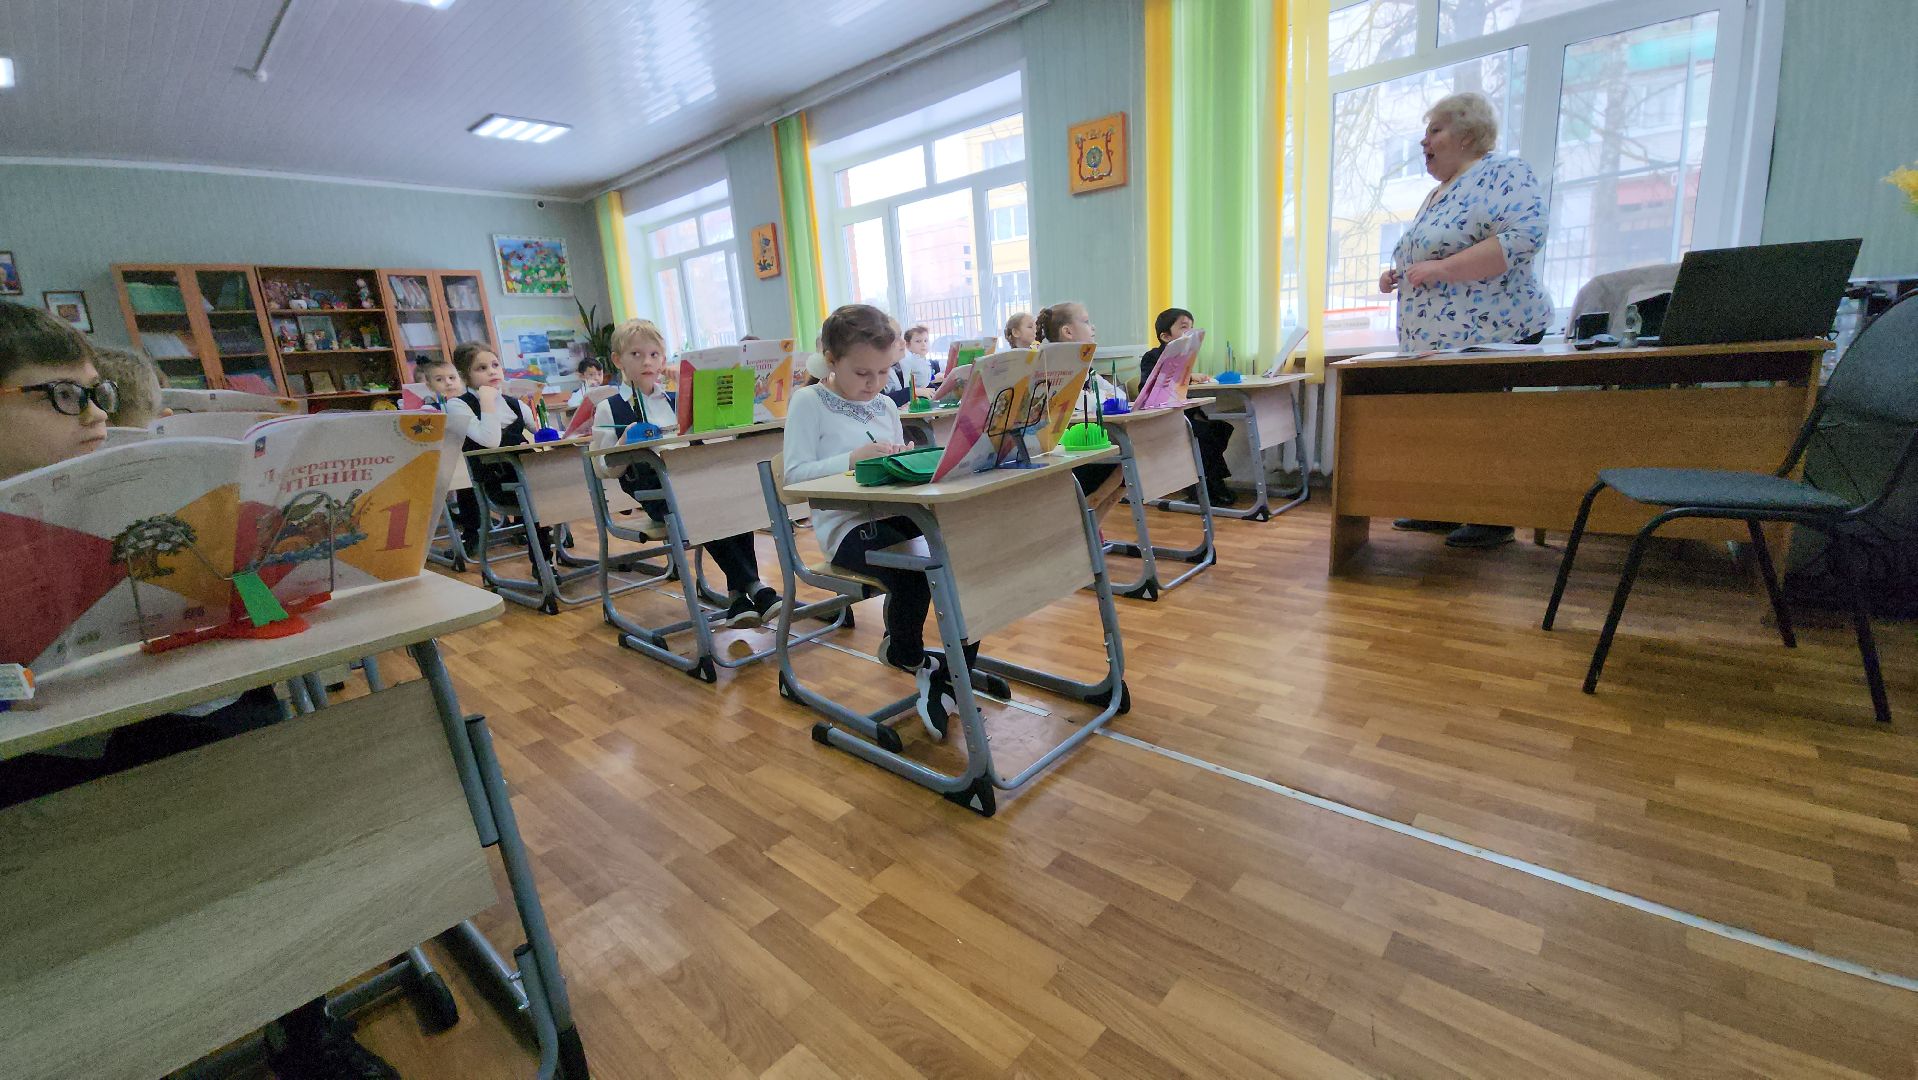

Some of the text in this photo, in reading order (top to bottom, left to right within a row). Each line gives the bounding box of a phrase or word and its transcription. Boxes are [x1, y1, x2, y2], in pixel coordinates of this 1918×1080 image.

[263, 455, 395, 482] Лтературное
[279, 468, 373, 493] ЧТЕНИЕ
[376, 500, 413, 552] 1
